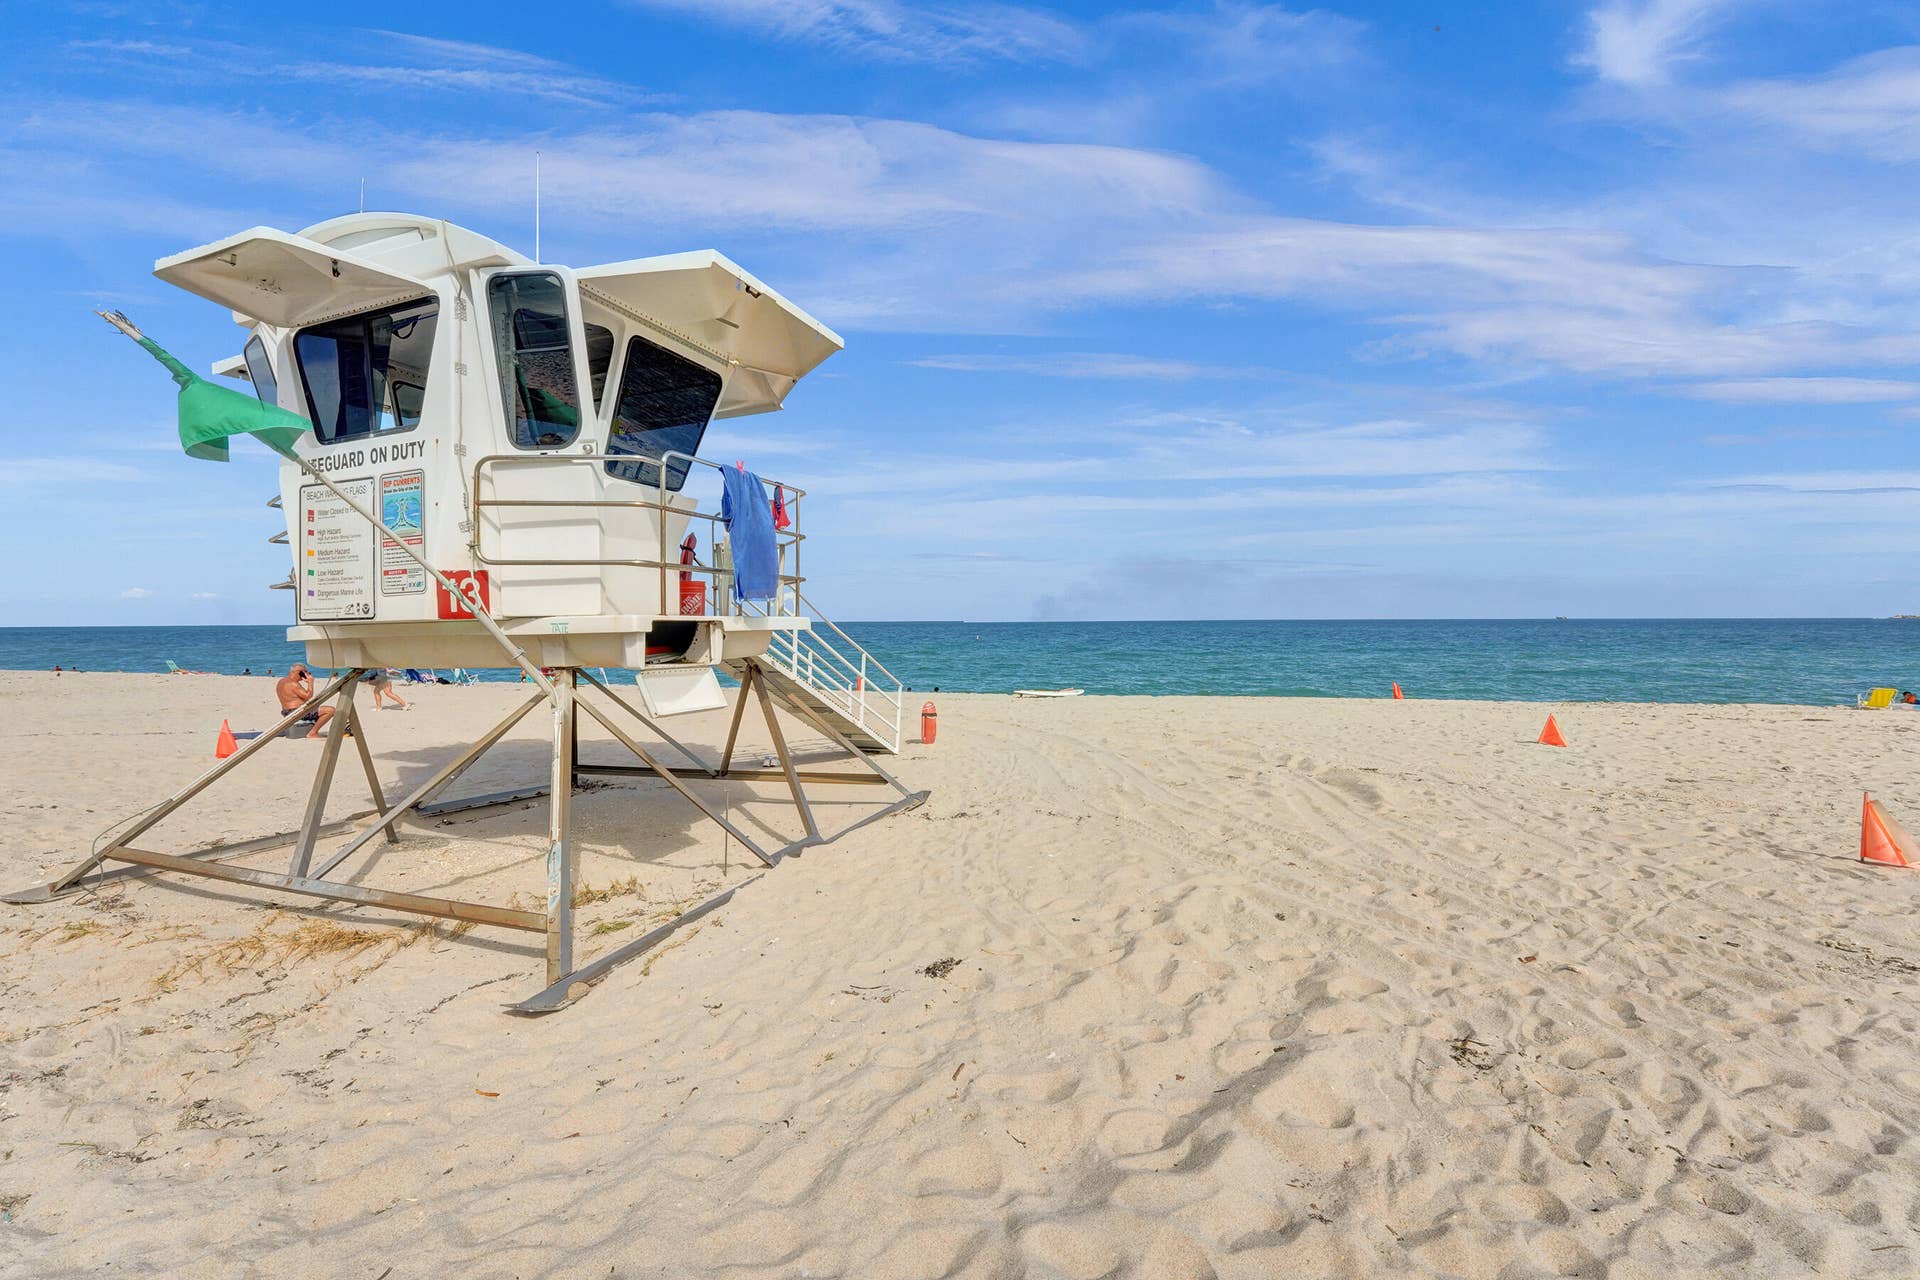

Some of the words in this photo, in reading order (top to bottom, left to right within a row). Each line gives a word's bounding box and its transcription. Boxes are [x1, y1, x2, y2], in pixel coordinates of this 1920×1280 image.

[370, 446, 387, 464] ON
[391, 440, 426, 461] DUTY
[384, 480, 392, 488] RIP
[393, 477, 421, 486] CURRENTS
[306, 489, 324, 501] BEACH
[349, 484, 368, 497] FLAGS
[330, 506, 344, 515] Closed
[326, 527, 342, 535] Hazard
[334, 547, 351, 555] Hazard
[317, 569, 327, 577] Low
[327, 568, 344, 576] Hazard
[317, 589, 340, 598] Dangerous
[442, 577, 481, 613] 13
